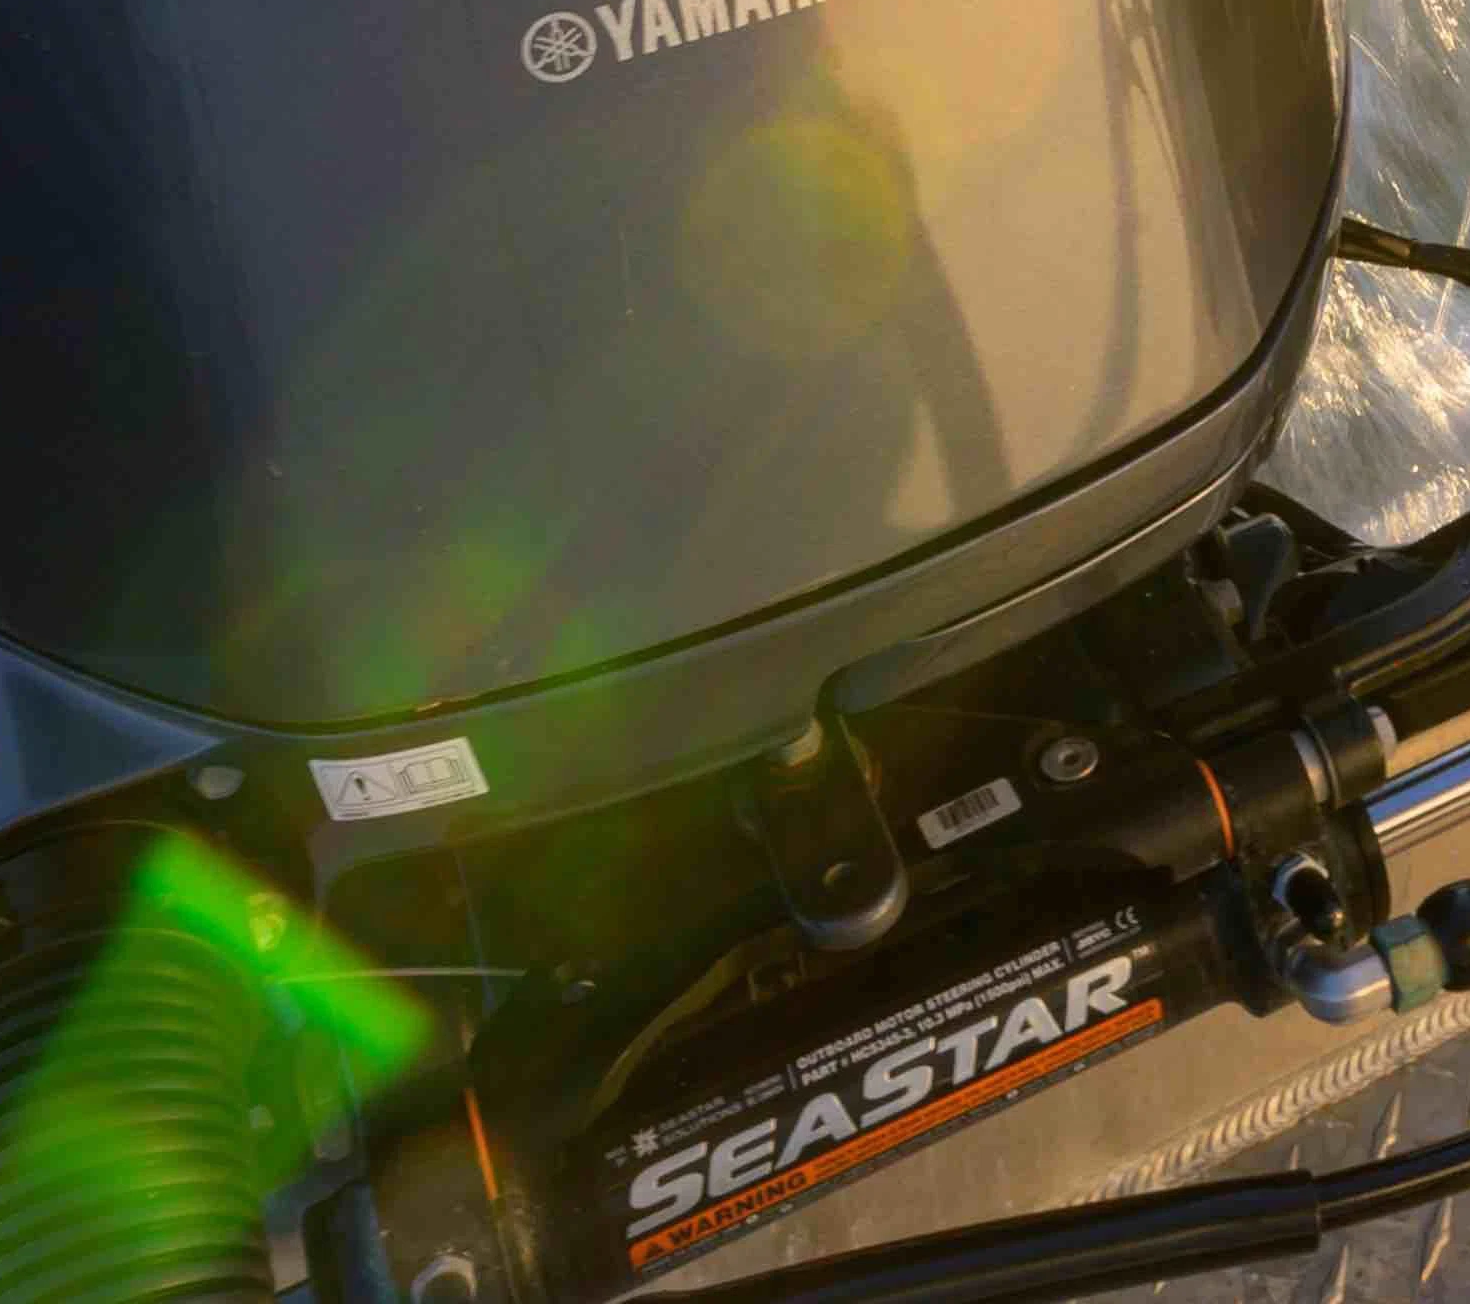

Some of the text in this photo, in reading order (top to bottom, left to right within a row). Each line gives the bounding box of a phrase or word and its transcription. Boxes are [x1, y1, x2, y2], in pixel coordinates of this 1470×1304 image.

[796, 1024, 872, 1071] OUTBOARD
[875, 1001, 923, 1035] MOTOR
[926, 970, 991, 1012] STEERING
[994, 938, 1059, 980] CYLINDER
[625, 955, 1134, 1239] SEASTAR
[802, 1059, 837, 1086] PART
[671, 1168, 806, 1247] WARNING
